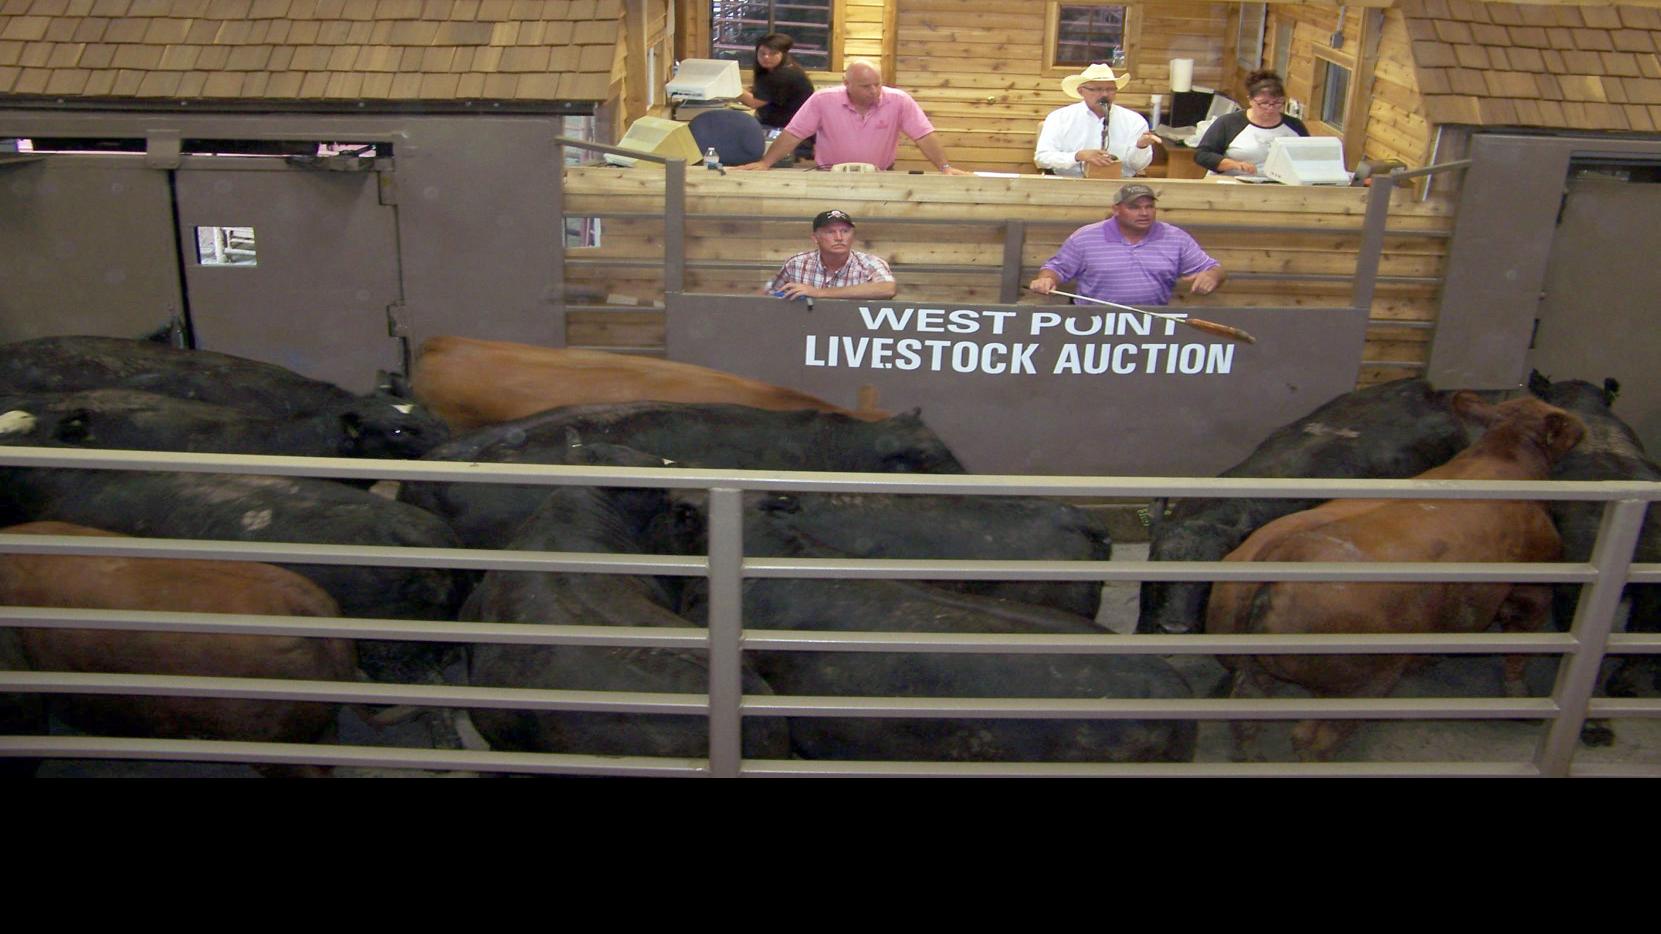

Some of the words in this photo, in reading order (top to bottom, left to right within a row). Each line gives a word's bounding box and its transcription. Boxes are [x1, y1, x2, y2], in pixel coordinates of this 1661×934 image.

[858, 307, 1017, 335] WEST
[1030, 312, 1188, 336] POINT
[805, 335, 1040, 374] LIVESTOCK
[1053, 343, 1235, 375] AUCTION
